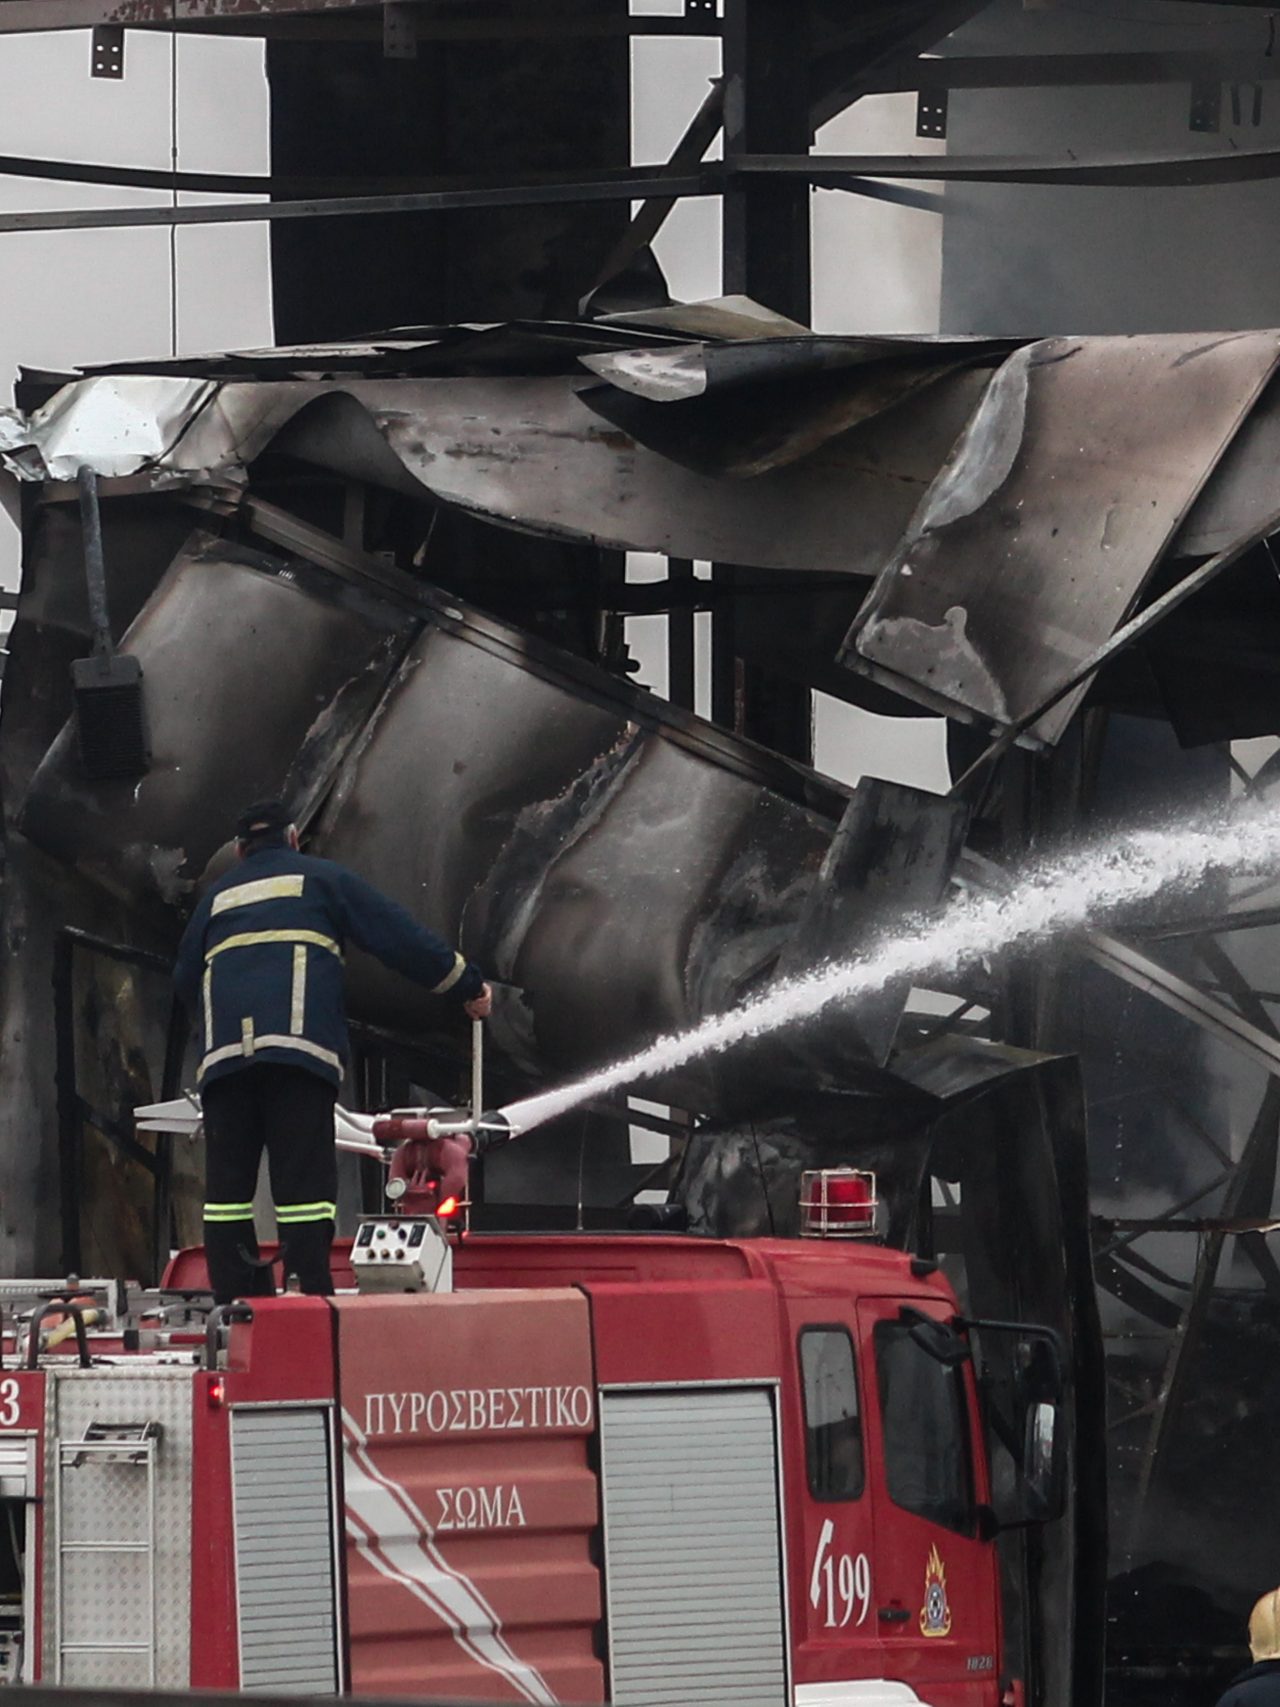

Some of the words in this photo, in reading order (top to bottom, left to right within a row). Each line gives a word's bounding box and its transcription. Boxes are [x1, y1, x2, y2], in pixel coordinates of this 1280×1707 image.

[0, 1378, 20, 1426] 3
[364, 1385, 592, 1435] ΠΥΡΟΣΒΕΣΤΙΚΟ
[436, 1484, 527, 1530] ΣΩΜΑ
[822, 1552, 870, 1627] 199
